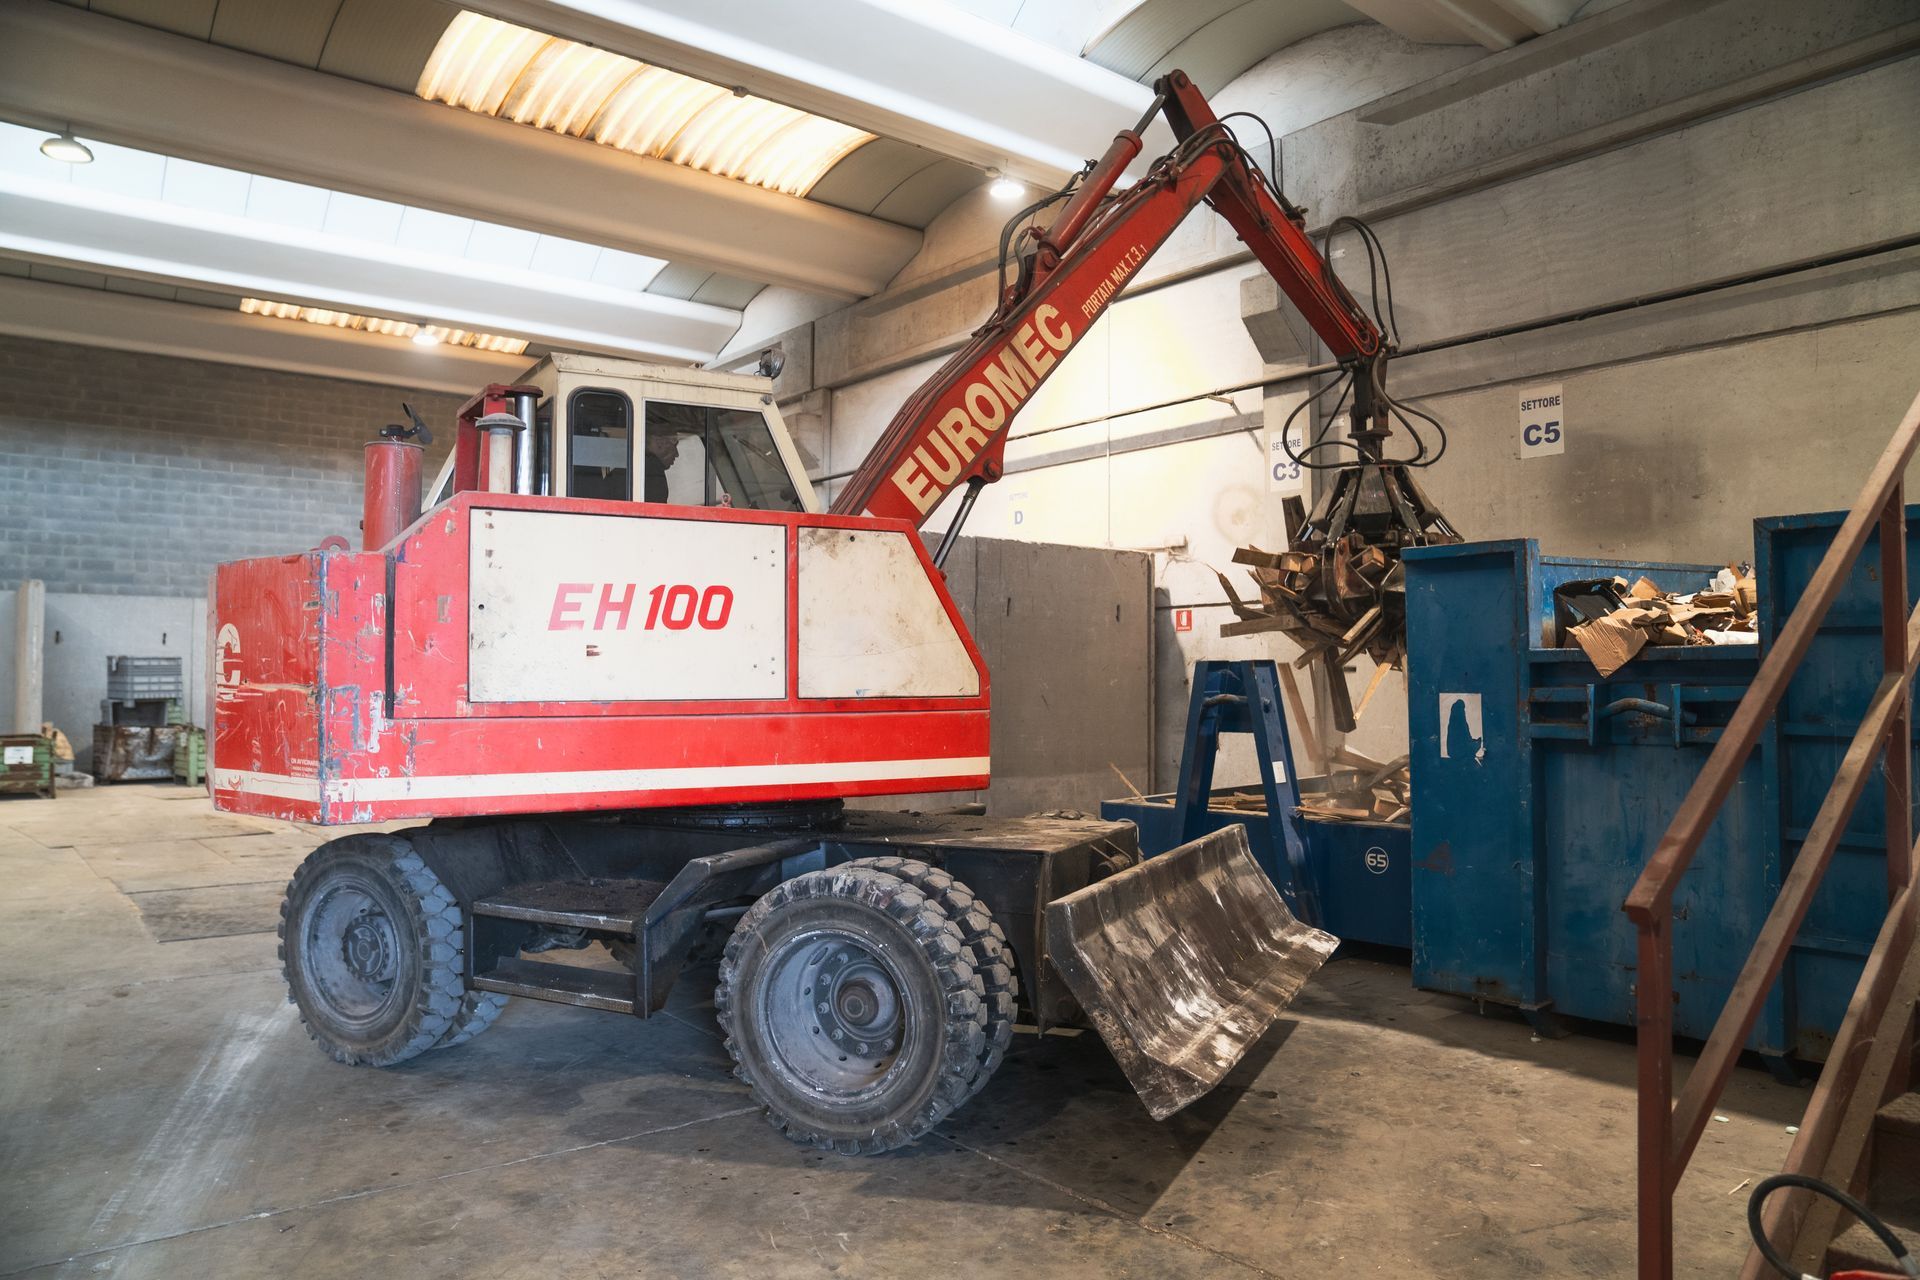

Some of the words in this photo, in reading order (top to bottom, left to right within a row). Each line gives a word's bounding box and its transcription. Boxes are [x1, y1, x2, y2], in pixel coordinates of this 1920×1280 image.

[1081, 279, 1116, 319] PORTATA
[890, 303, 1073, 516] EUROMEC
[1521, 395, 1561, 411] SETTORE
[1523, 421, 1561, 446] C5
[1271, 439, 1301, 451] SETORE
[1272, 461, 1300, 481] C3
[1014, 510, 1024, 525] D
[548, 583, 637, 631] EH
[644, 585, 734, 631] 100
[1367, 853, 1387, 868] 65
